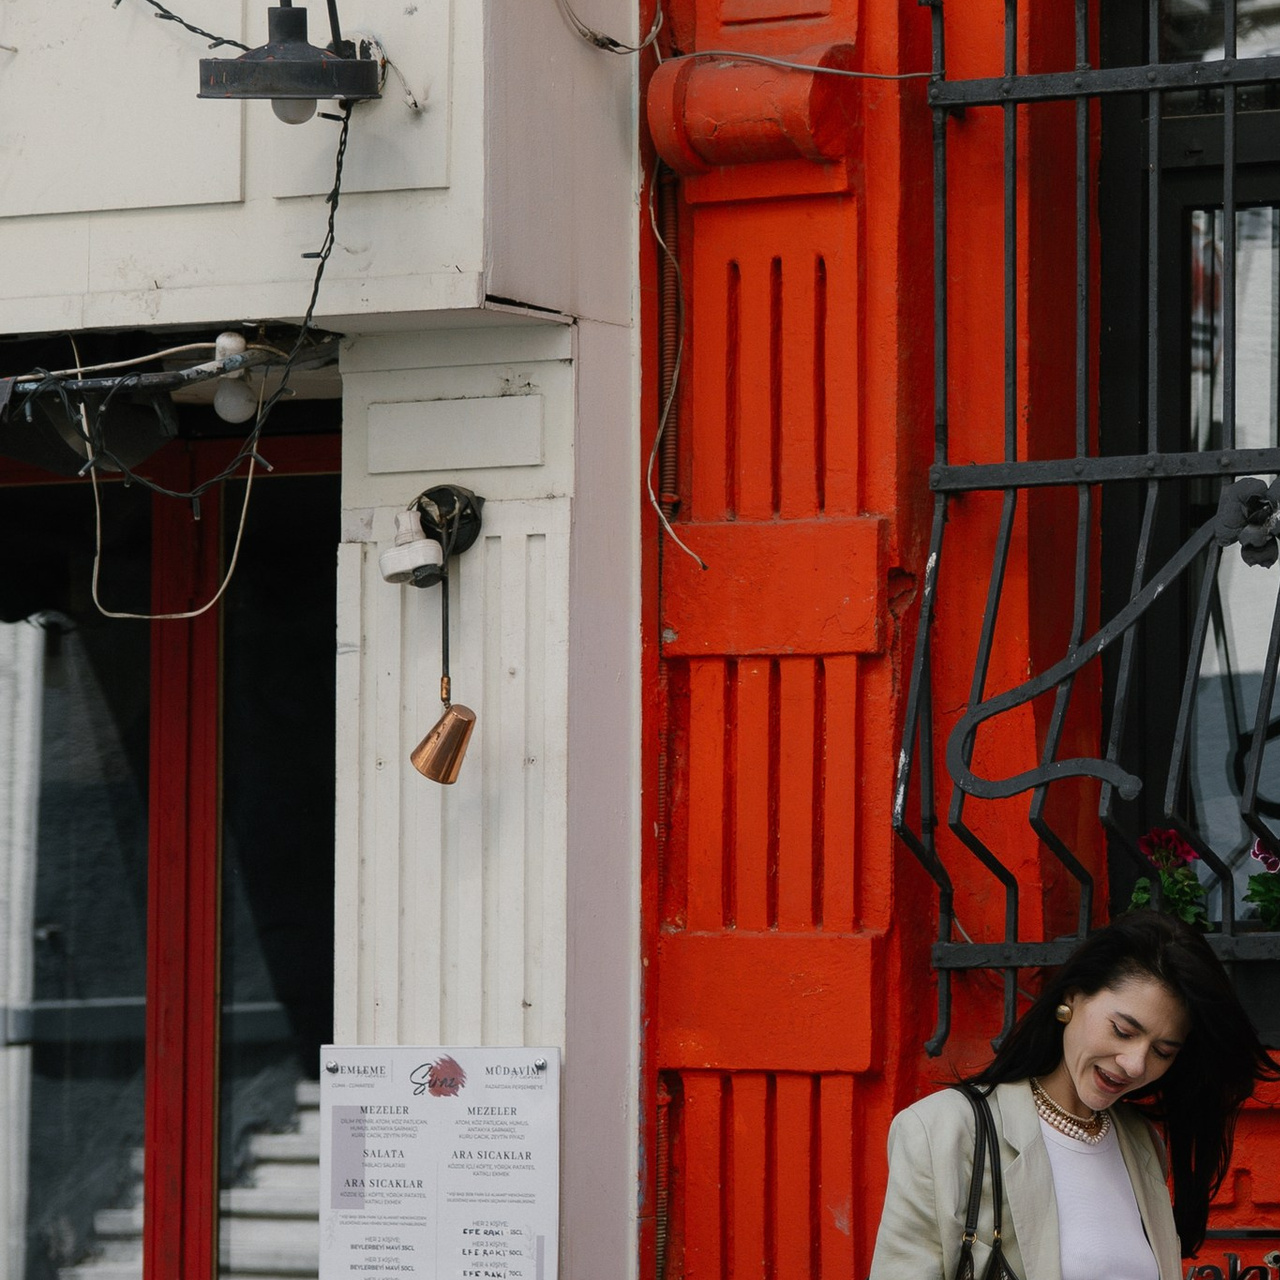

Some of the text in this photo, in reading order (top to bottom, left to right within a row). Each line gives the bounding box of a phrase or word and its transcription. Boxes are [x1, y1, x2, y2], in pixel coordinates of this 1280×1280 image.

[338, 1065, 386, 1075] EMLEME
[360, 1105, 409, 1115] MEZELER
[467, 1106, 517, 1116] MEZELER
[363, 1149, 405, 1158] SALATA
[451, 1151, 532, 1160] ARA SICAKLAR
[344, 1179, 423, 1188] ARA SICAKLAR
[463, 1228, 480, 1236] EFE
[483, 1228, 504, 1236] RAKI
